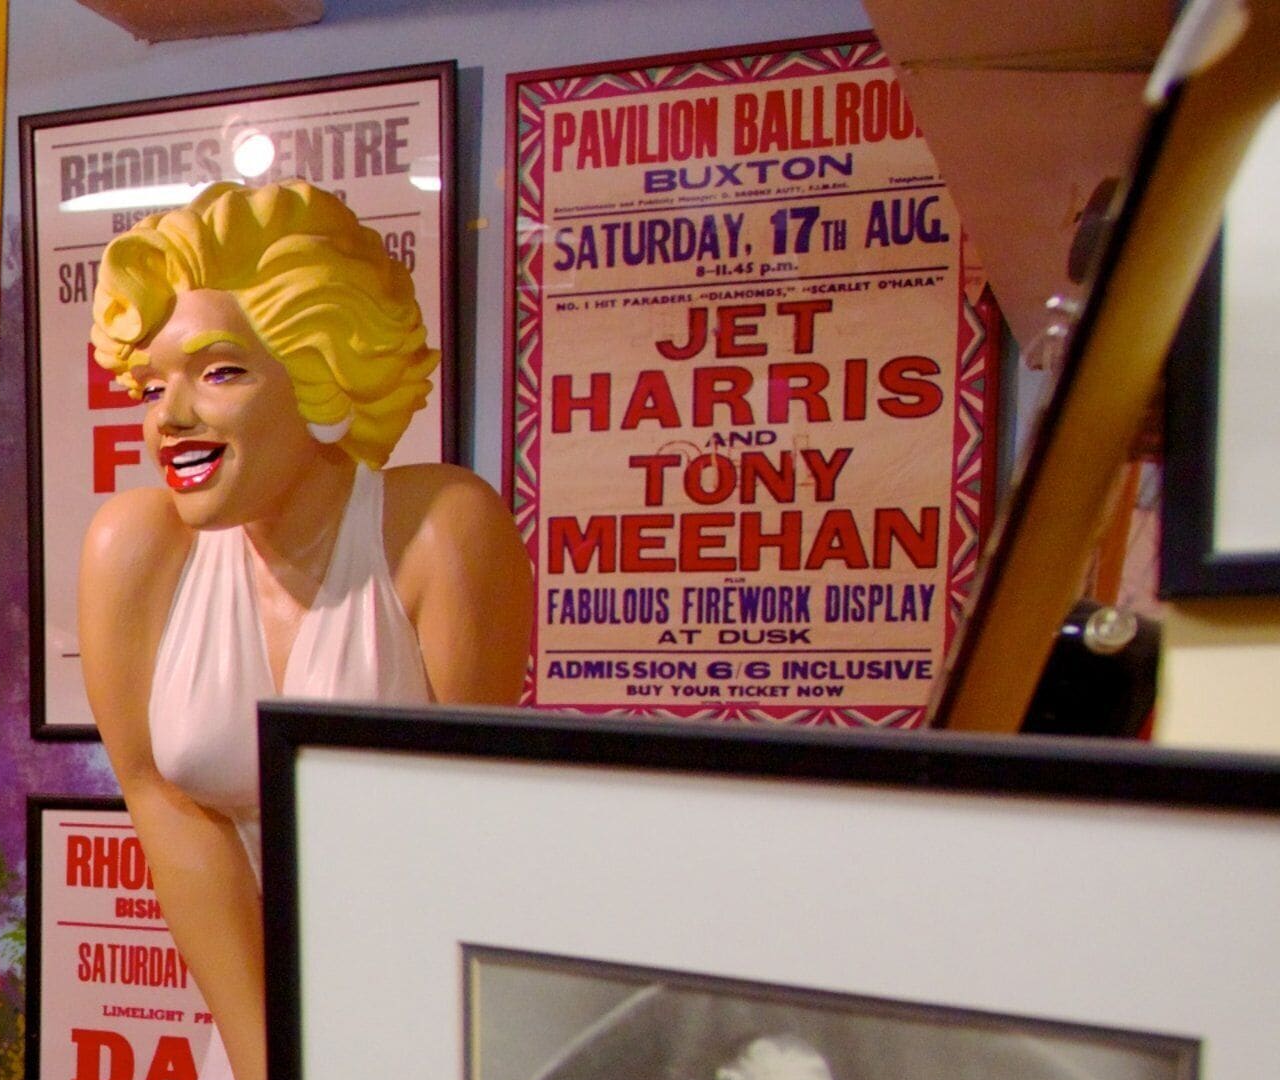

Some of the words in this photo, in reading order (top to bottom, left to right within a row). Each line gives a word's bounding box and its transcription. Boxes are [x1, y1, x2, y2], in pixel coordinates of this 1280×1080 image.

[552, 97, 719, 172] PAVILION
[733, 78, 925, 154] BALLROO
[60, 139, 223, 203] RHODES
[272, 117, 411, 184] ENTRE
[644, 153, 853, 194] BUXTON
[553, 212, 753, 272] SATURDAY,
[770, 205, 848, 256] 17TH
[865, 195, 949, 249] AUG.
[760, 262, 799, 278] p.m.
[556, 301, 580, 312] NO.
[595, 298, 618, 309] HIT
[622, 293, 693, 307] PARADERS
[655, 299, 834, 361] JET
[552, 355, 945, 434] HARRIS
[705, 429, 777, 448] AND
[629, 447, 854, 507] TONY
[548, 507, 941, 575] MEEHAN
[547, 587, 670, 625] FABULOUS
[682, 585, 812, 625] FIREWORK
[825, 583, 936, 624] DISPLAY
[658, 630, 702, 645] AT
[718, 629, 812, 645] DUSK
[547, 661, 697, 680] ADMISSION
[783, 660, 933, 680] INCLUSIVE
[627, 684, 662, 697] BUY
[672, 684, 721, 697] YOUR
[728, 684, 790, 698] TICKET
[797, 684, 845, 697] NOW
[66, 834, 155, 890] RHO
[115, 897, 163, 920] BISH
[78, 942, 188, 989] SATURDAY
[103, 1004, 184, 1023] LIMELIGHT
